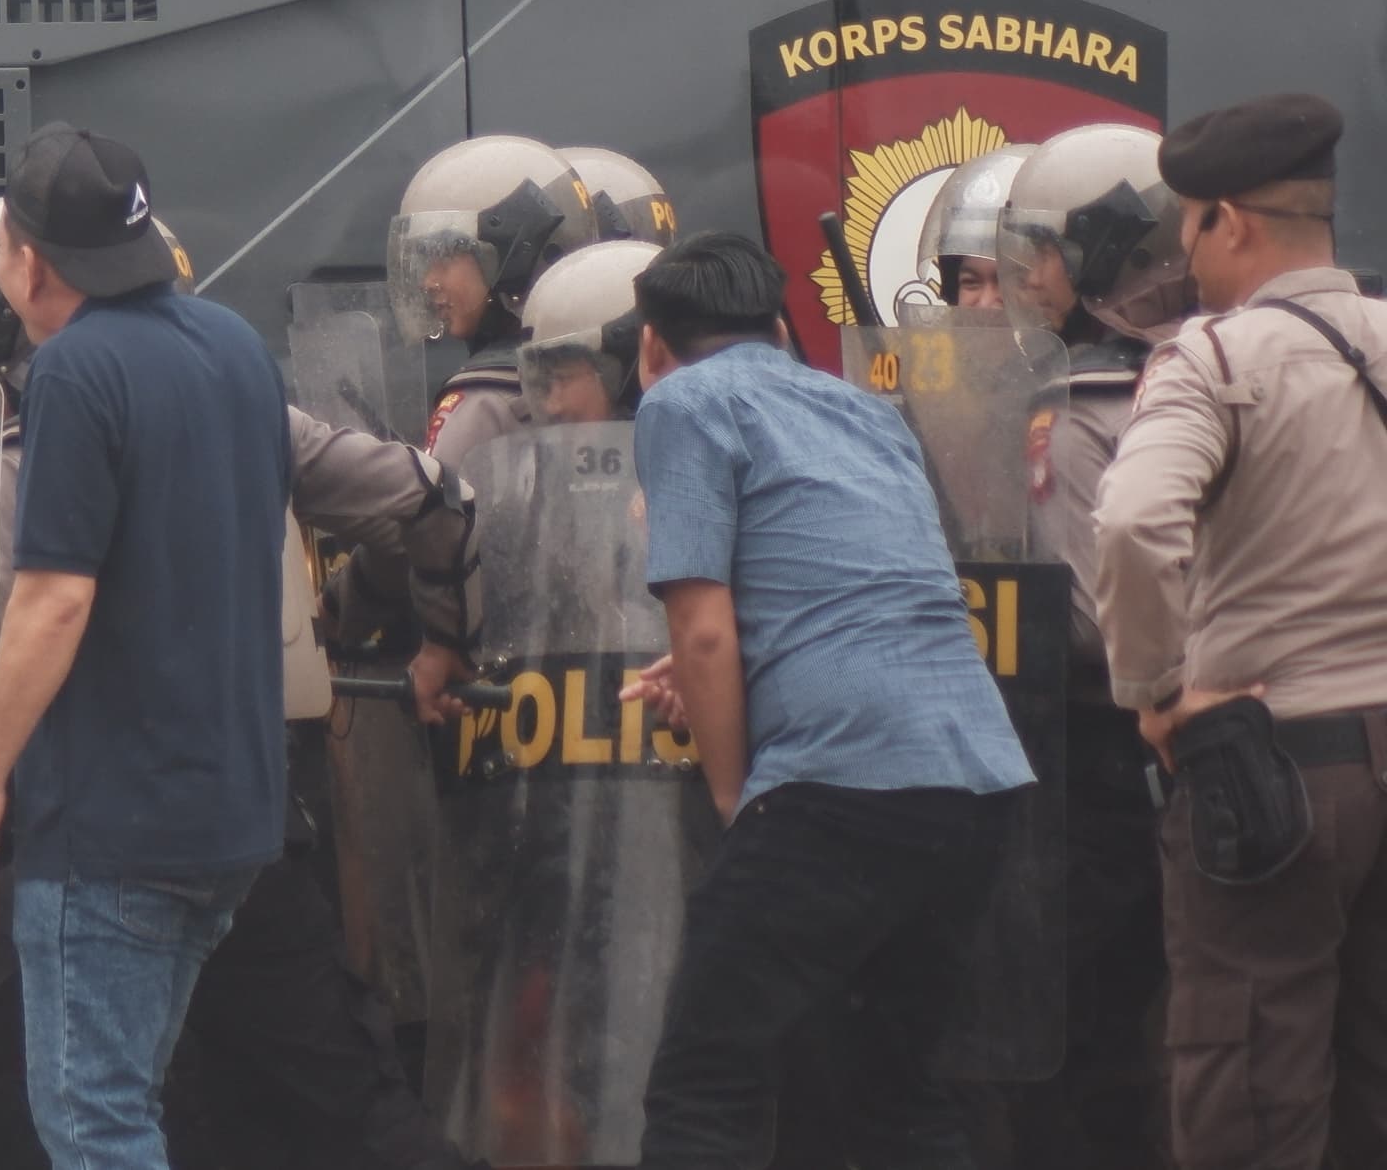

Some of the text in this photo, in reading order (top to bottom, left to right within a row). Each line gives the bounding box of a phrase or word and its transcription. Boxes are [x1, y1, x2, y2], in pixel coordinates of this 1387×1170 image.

[779, 14, 1138, 82] KORPS SABHARA
[869, 352, 899, 391] 40
[576, 445, 622, 476] 36
